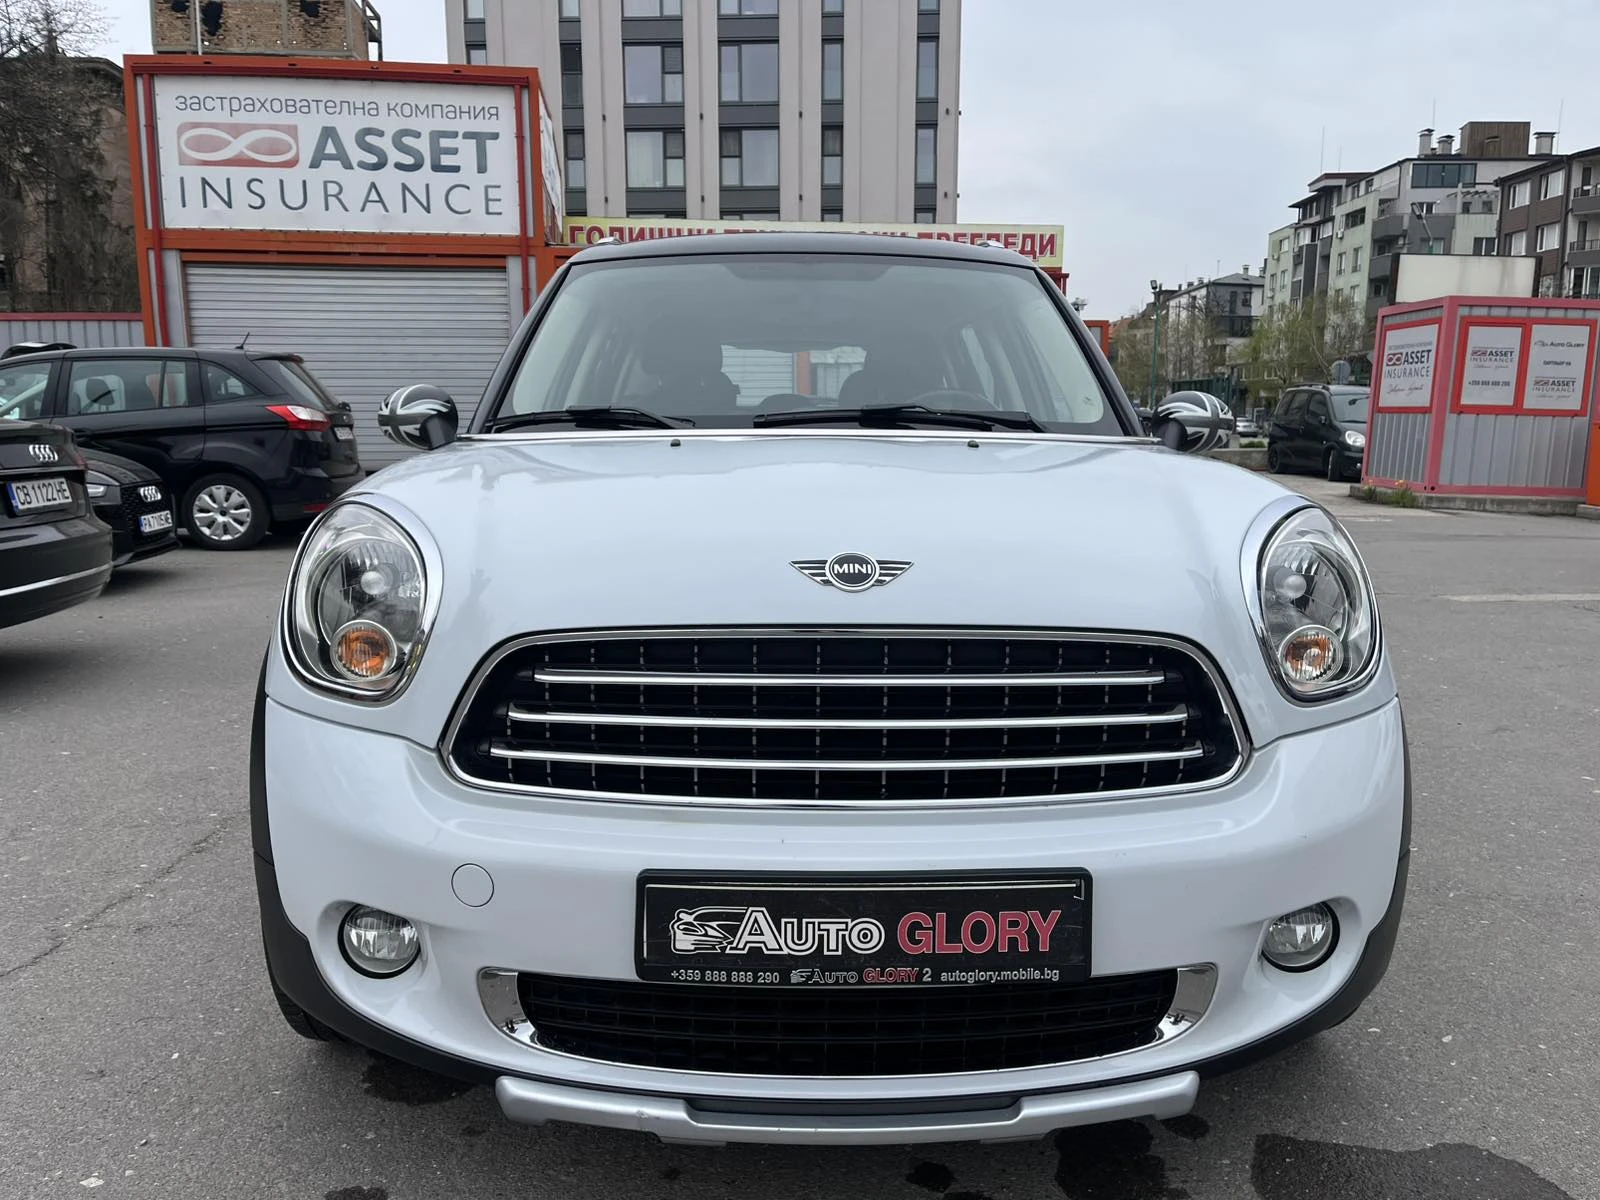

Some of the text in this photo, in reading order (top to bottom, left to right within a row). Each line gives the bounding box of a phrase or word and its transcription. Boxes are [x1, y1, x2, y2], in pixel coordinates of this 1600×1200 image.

[175, 95, 500, 121] застрахователна компания
[308, 125, 500, 174] ASSET
[178, 176, 503, 216] INSURANCE
[1403, 349, 1433, 366] ASSET
[1384, 366, 1430, 379] INSURANCE
[833, 563, 872, 574] MINI
[897, 910, 1062, 955] GLORY
[671, 969, 701, 981] +359
[705, 970, 727, 982] 888
[731, 971, 753, 983] 888
[757, 972, 780, 983] 290
[863, 967, 919, 983] GLORY
[922, 968, 932, 982] 2
[940, 967, 1060, 983] autoglory.mobile.bg
